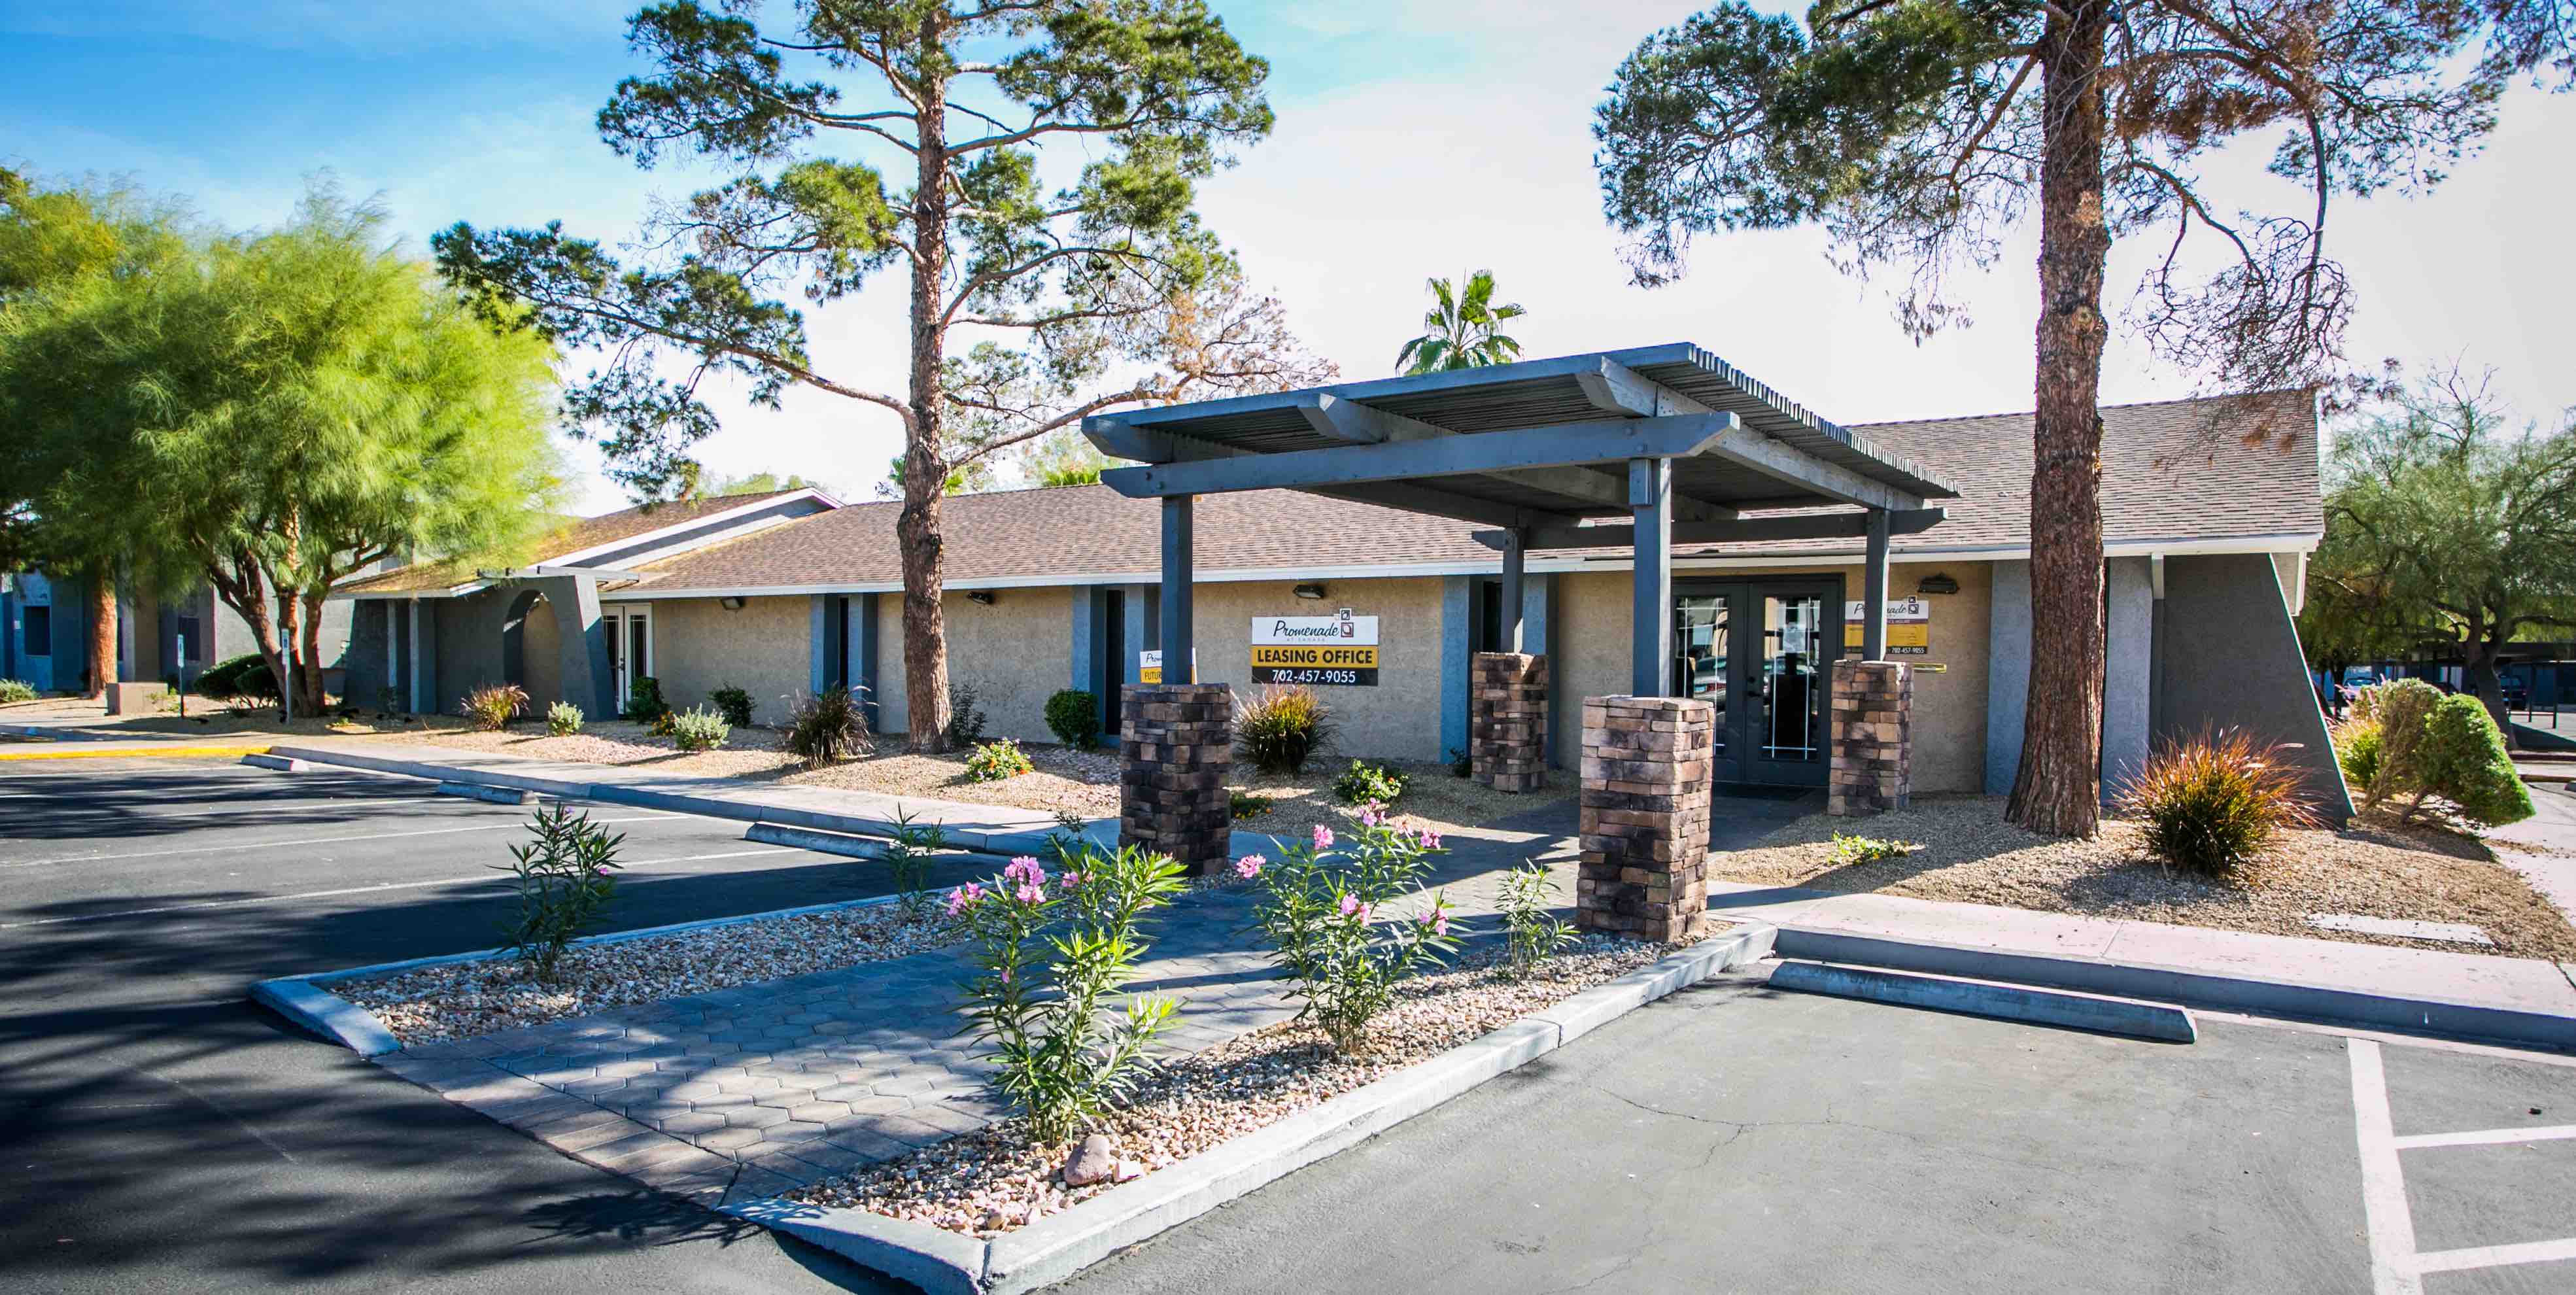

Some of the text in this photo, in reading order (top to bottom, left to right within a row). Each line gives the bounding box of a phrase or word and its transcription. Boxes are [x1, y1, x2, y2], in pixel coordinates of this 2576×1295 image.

[1273, 620, 1339, 637] Promenade
[1258, 649, 1372, 663] LEASING OFFICE
[1144, 672, 1161, 681] FUTUR
[1273, 669, 1356, 683] 702-457-9055
